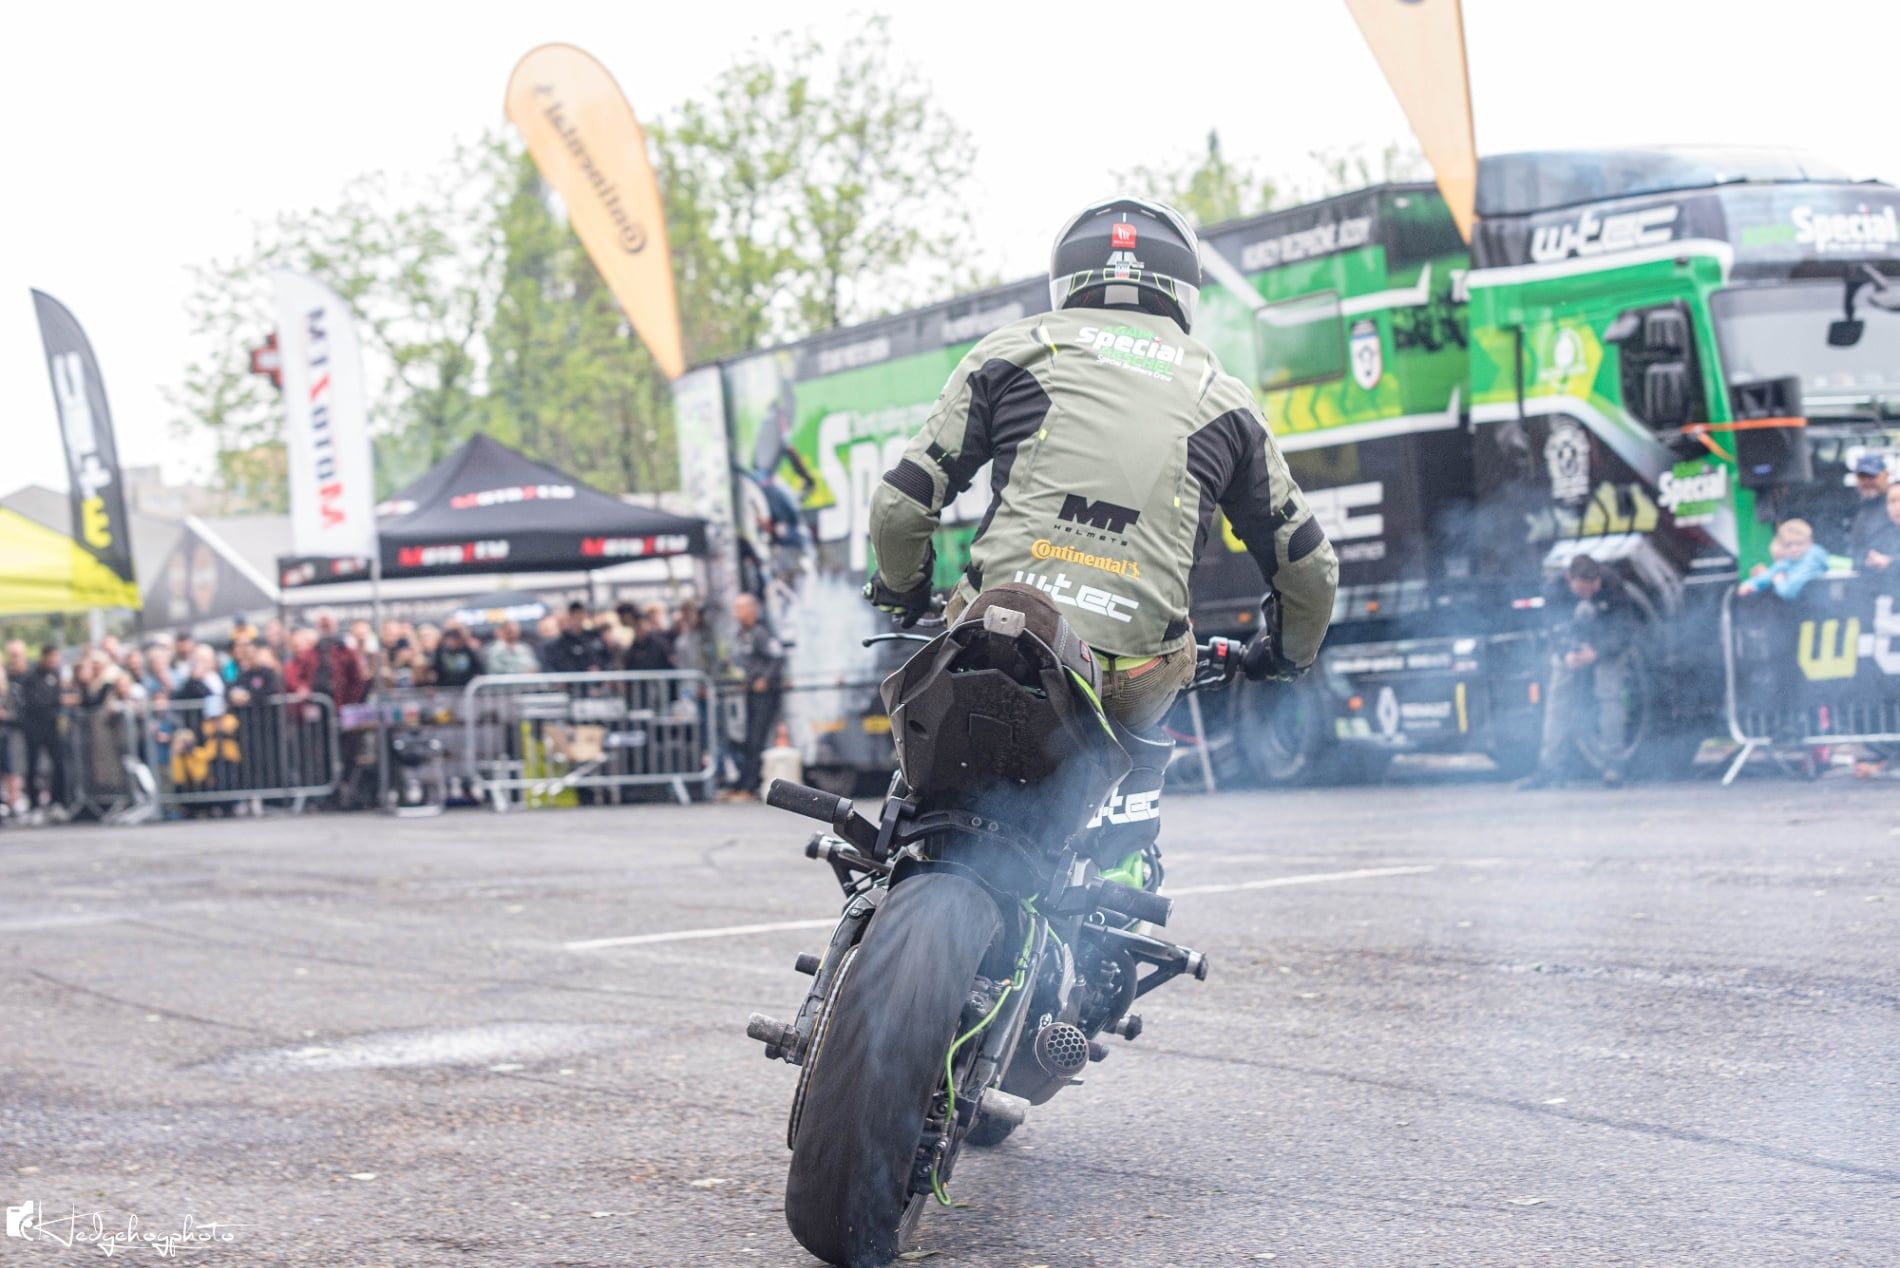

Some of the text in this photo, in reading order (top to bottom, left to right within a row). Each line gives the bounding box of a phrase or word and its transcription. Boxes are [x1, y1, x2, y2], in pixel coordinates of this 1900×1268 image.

[1791, 203, 1898, 253] Special
[1075, 326, 1184, 367] Special
[1658, 464, 1728, 514] Special
[1057, 493, 1141, 534] MT
[1053, 524, 1128, 547] HELMETS
[1030, 538, 1128, 577] Continental
